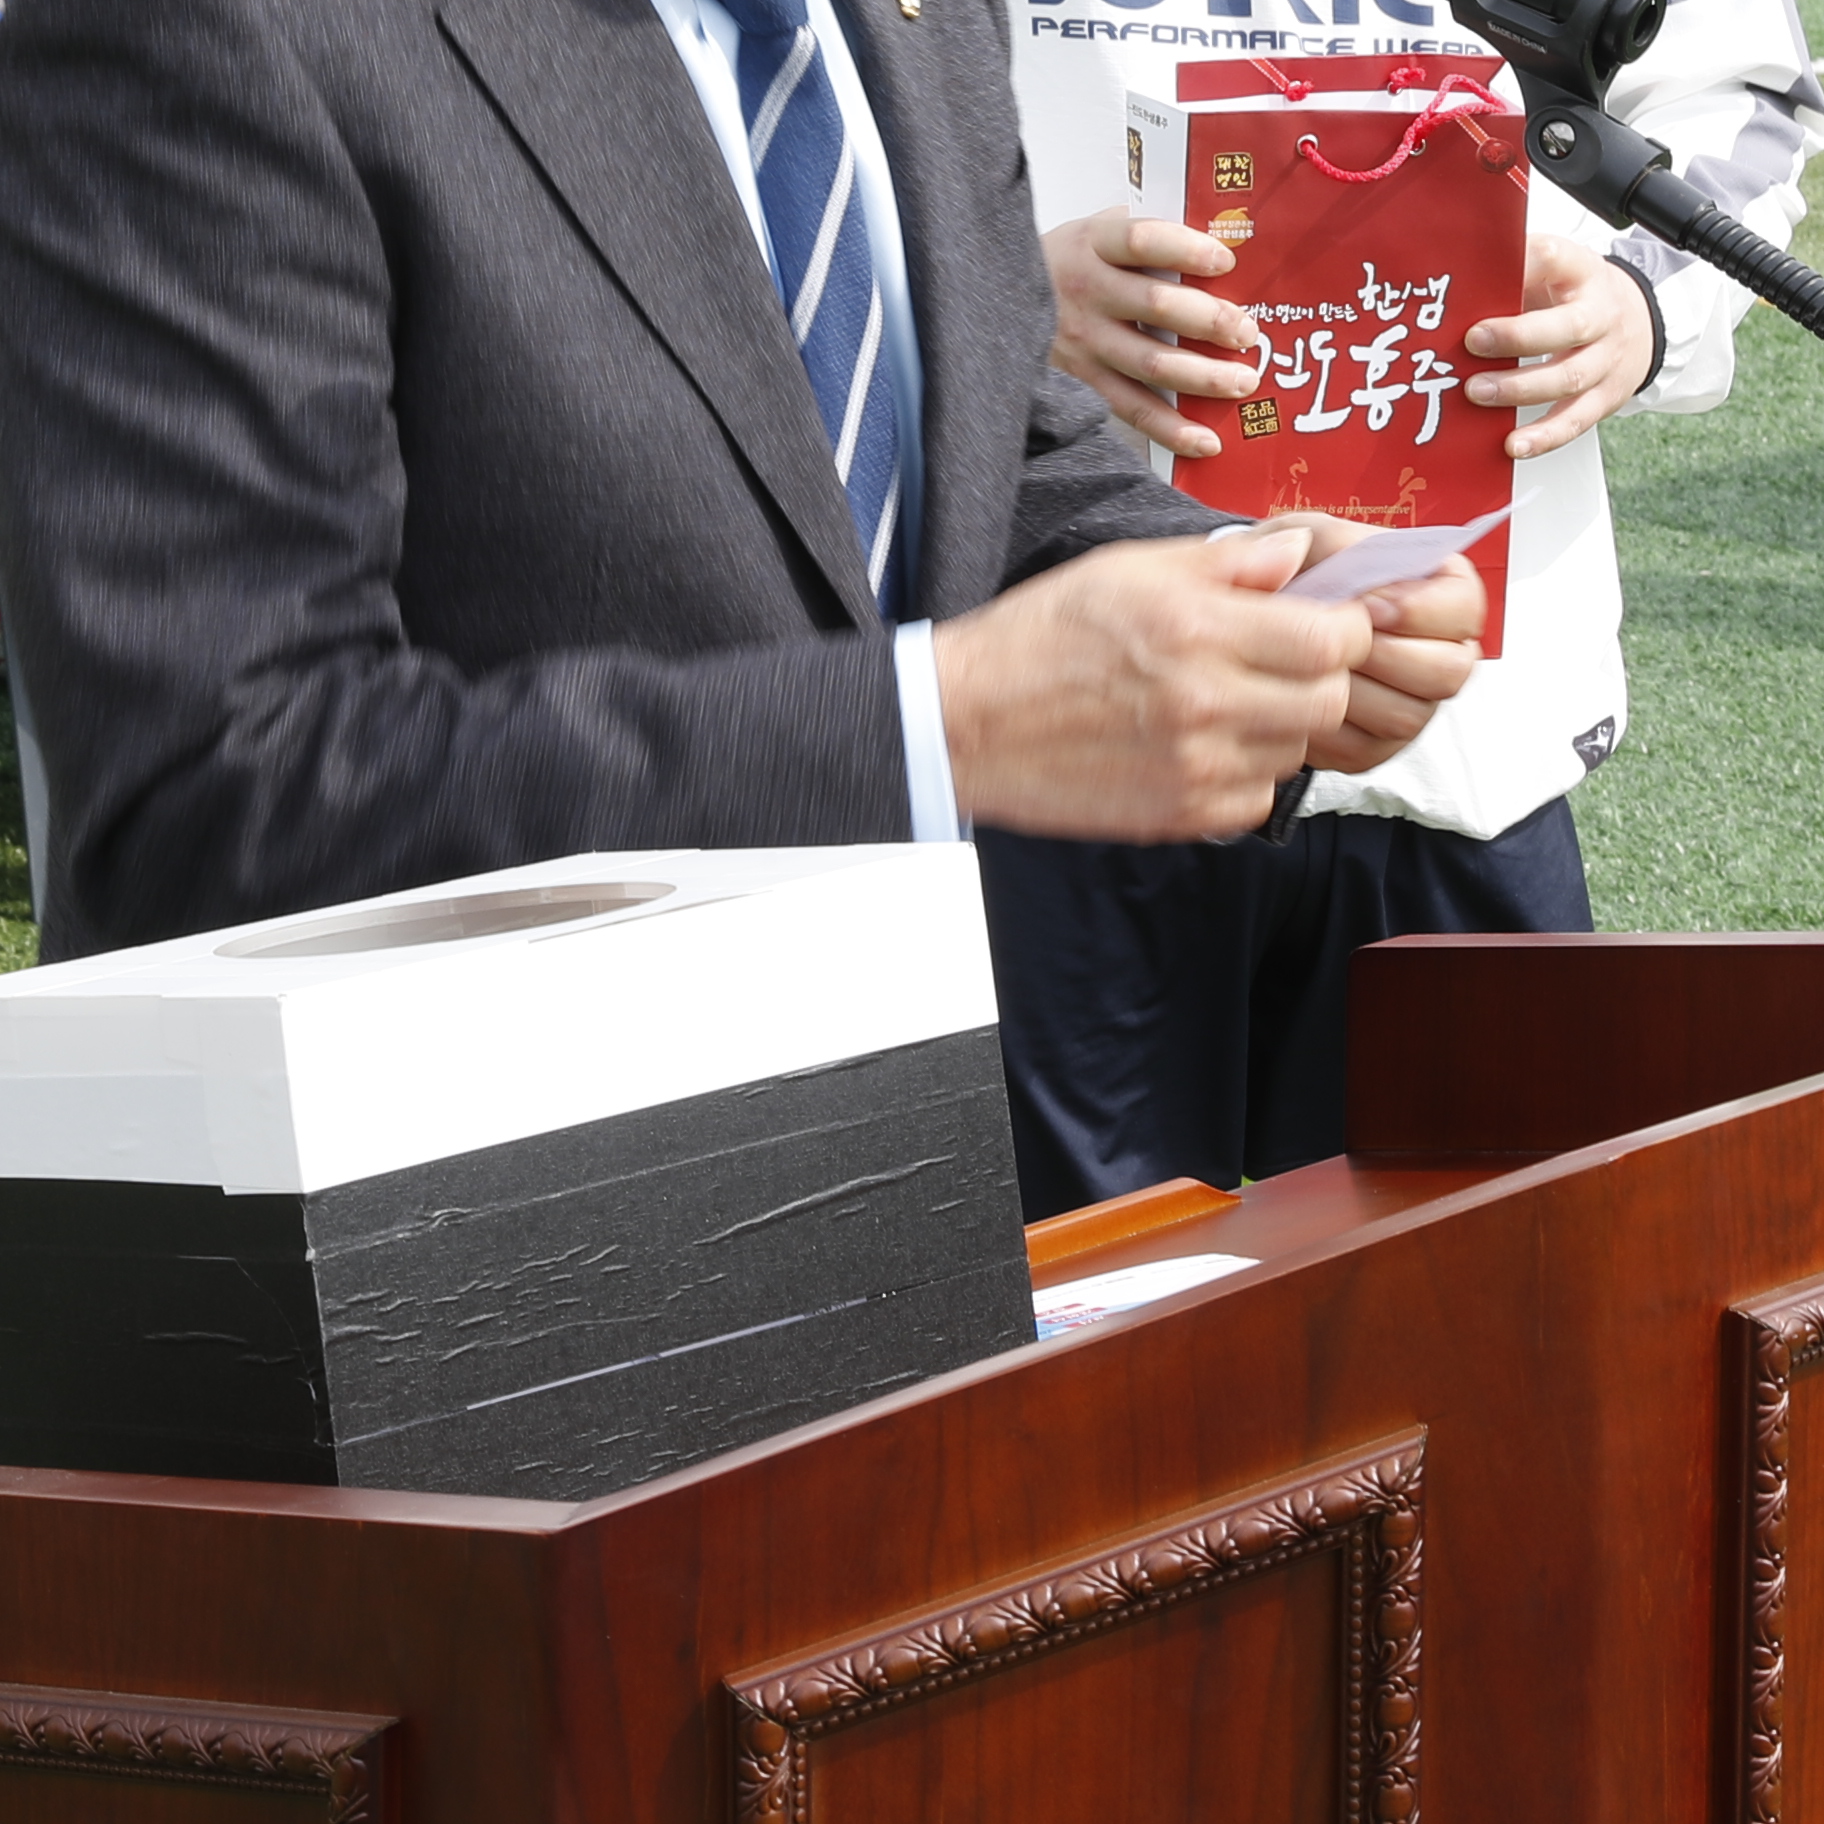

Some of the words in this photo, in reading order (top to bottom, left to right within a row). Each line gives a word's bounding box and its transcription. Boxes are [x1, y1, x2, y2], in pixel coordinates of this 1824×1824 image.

[1030, 15, 1356, 57] PERFORMANCE
[1318, 301, 1359, 323] 만드는
[1241, 400, 1277, 421] 名品
[1328, 504, 1336, 514] is
[1345, 504, 1412, 517] representative
